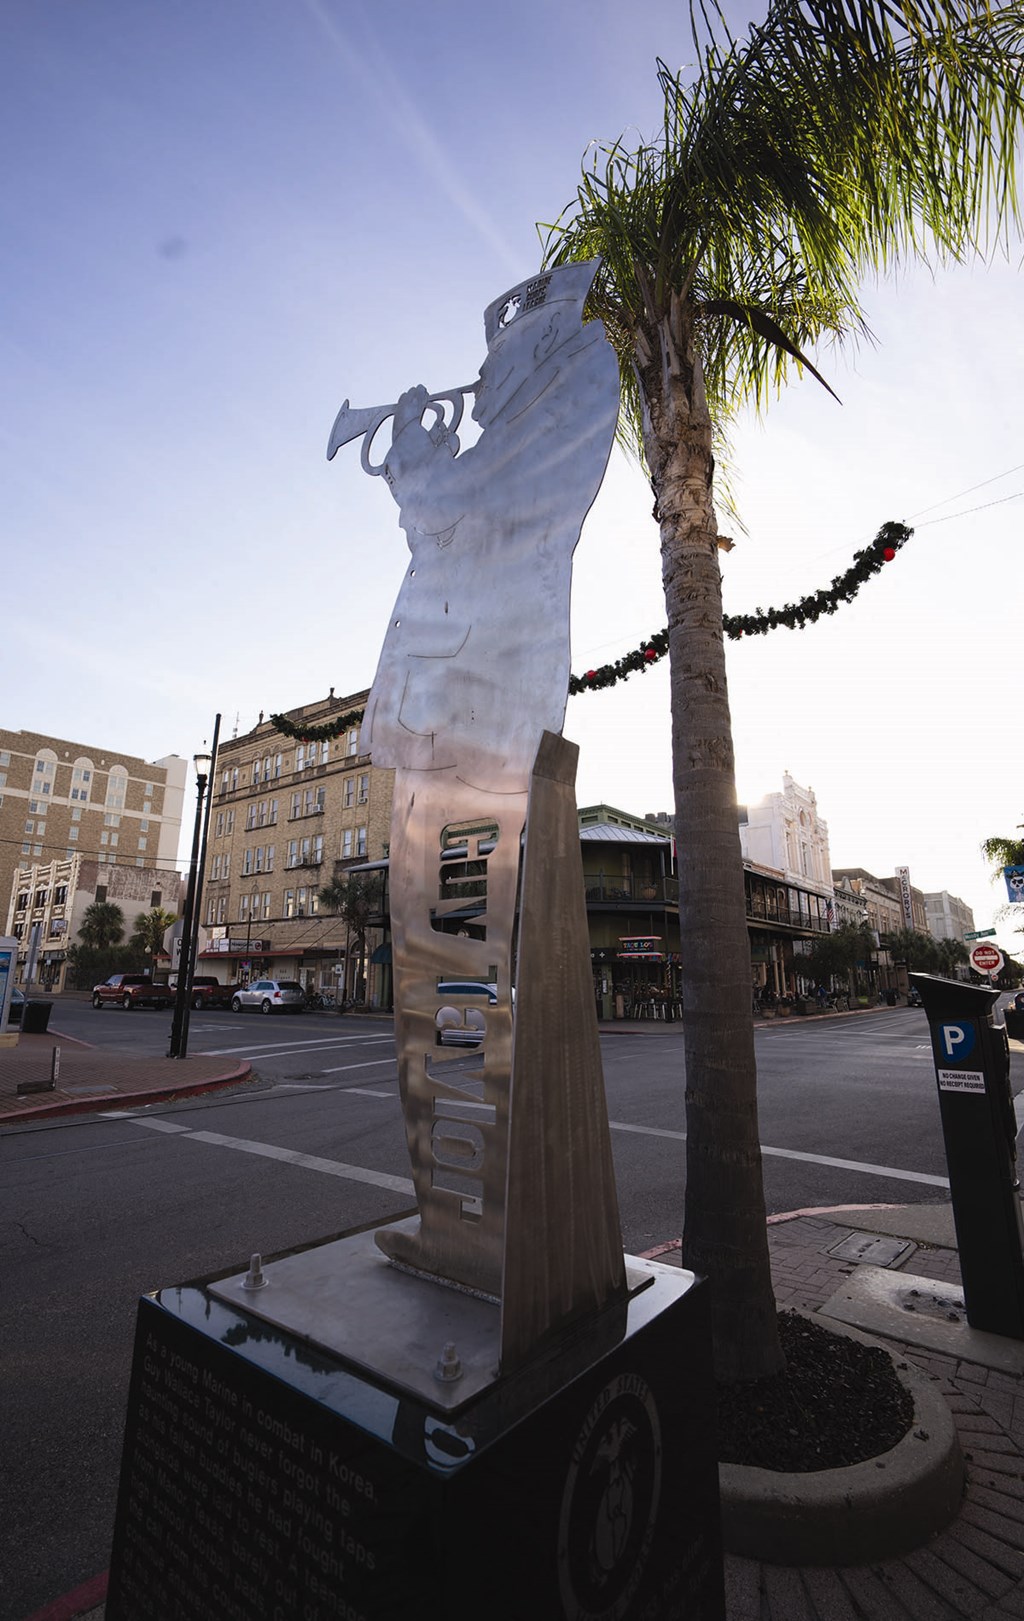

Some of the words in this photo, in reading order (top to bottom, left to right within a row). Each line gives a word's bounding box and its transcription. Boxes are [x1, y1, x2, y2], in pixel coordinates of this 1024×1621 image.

[943, 1026, 965, 1055] P
[143, 1355, 161, 1381] Guy
[164, 1369, 200, 1407] Wallace
[204, 1398, 236, 1433] Taylor
[240, 1426, 273, 1460] never
[278, 1450, 320, 1495] forgot
[326, 1484, 351, 1518] the
[147, 1333, 158, 1350] As
[161, 1346, 166, 1357] a
[170, 1351, 198, 1383] young
[203, 1370, 238, 1406] Marine
[243, 1396, 253, 1416] in
[257, 1406, 305, 1452] combat
[311, 1441, 323, 1464] in
[141, 1377, 179, 1422] haunting
[183, 1412, 213, 1445] sound
[218, 1435, 229, 1457] of
[233, 1447, 279, 1496] buglers
[283, 1489, 333, 1544] playing
[340, 1529, 376, 1573] taps
[183, 1468, 208, 1499] were
[237, 1510, 250, 1535] to
[200, 1449, 243, 1497] buddies
[248, 1489, 263, 1515] he
[268, 1505, 291, 1538] had
[298, 1527, 345, 1583] fought
[188, 1525, 230, 1579] football
[232, 1536, 269, 1589] barely
[275, 1579, 297, 1611] out
